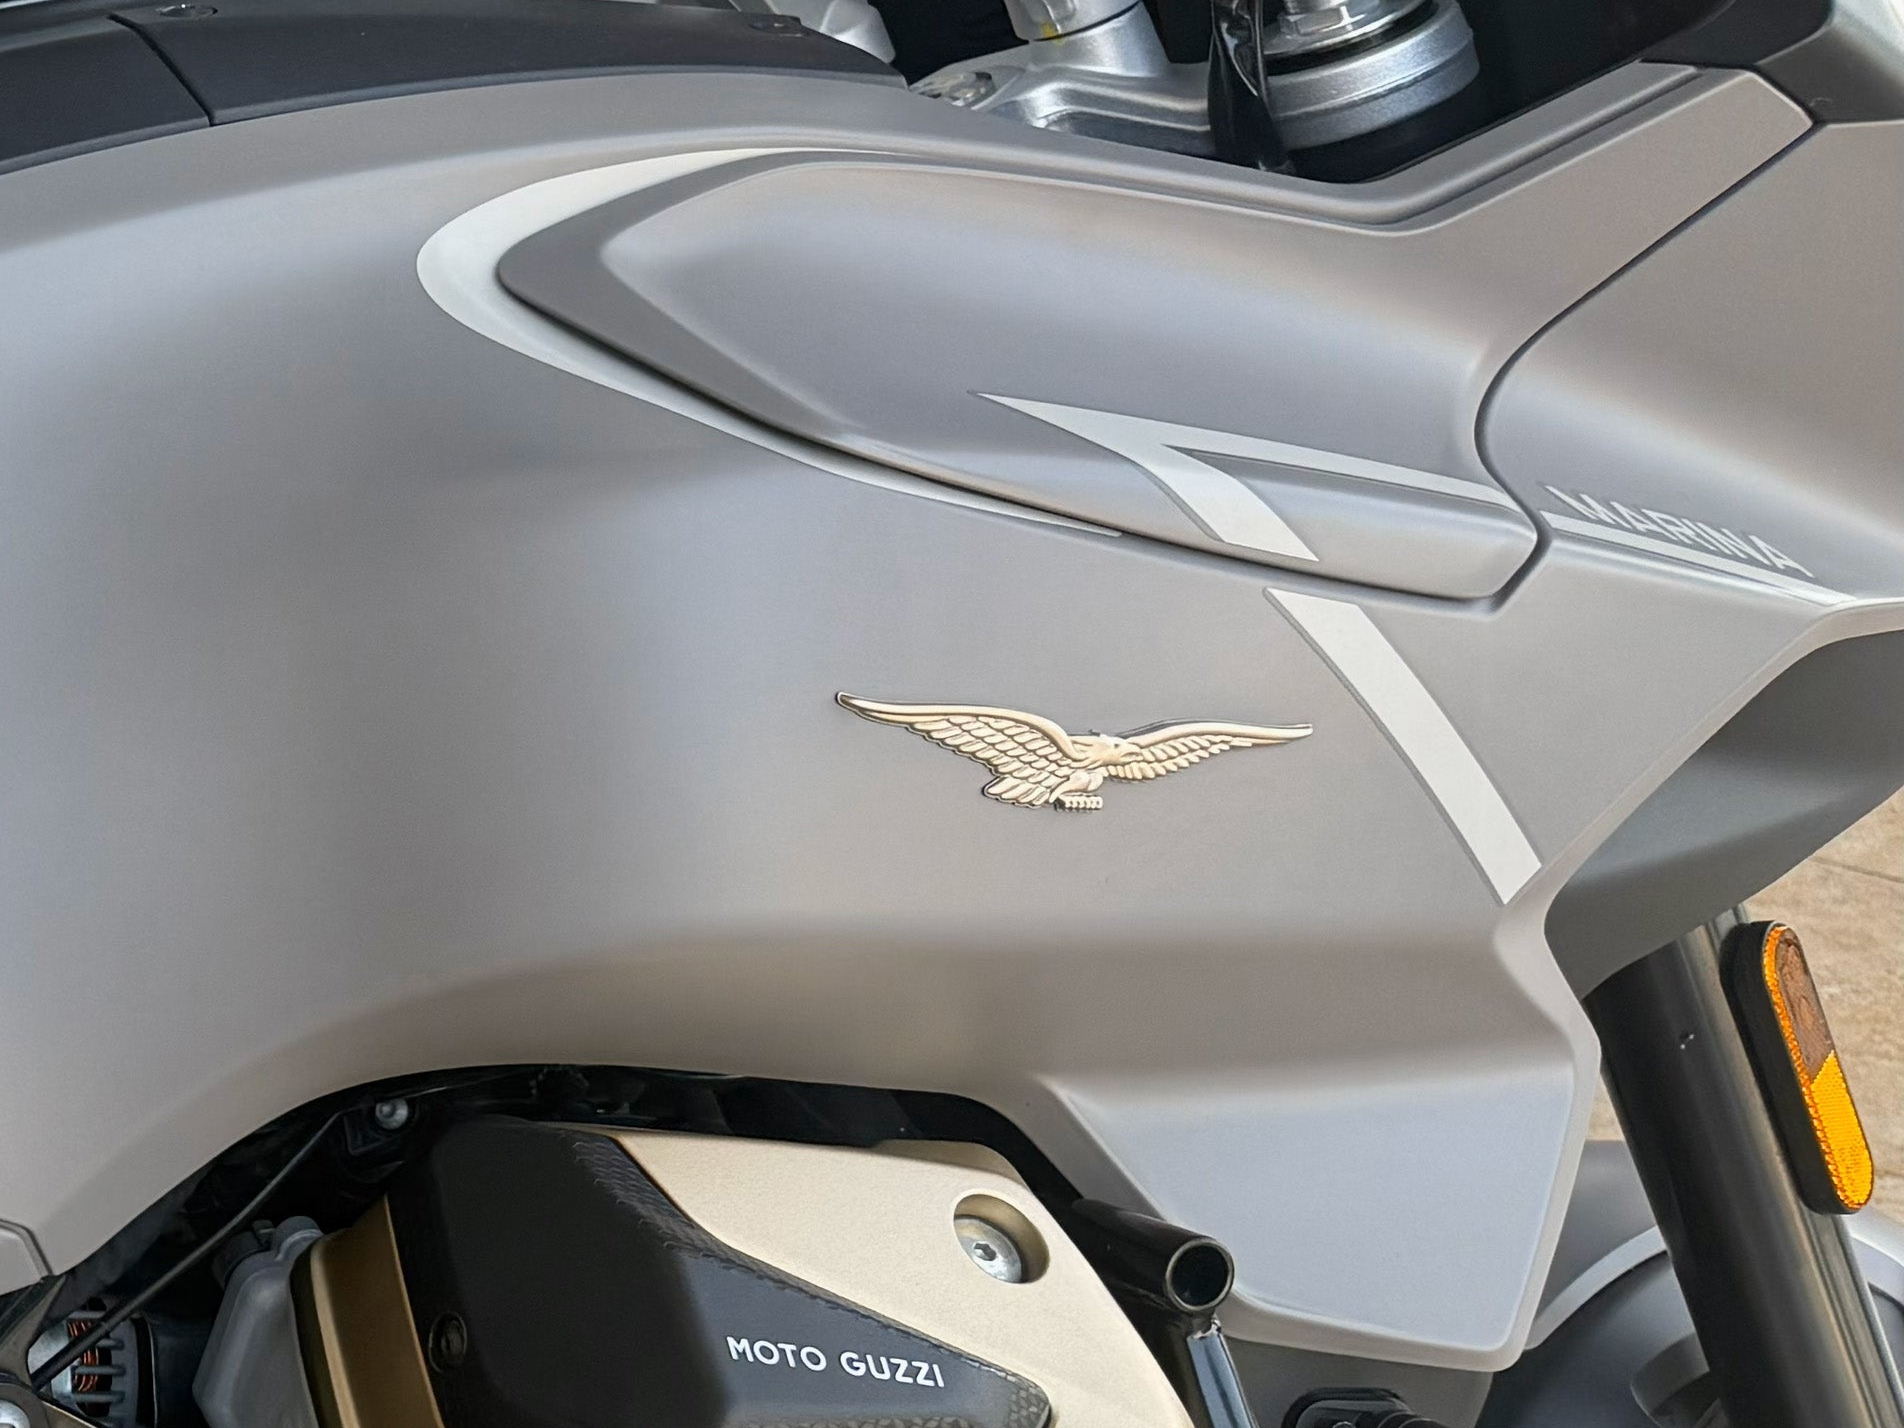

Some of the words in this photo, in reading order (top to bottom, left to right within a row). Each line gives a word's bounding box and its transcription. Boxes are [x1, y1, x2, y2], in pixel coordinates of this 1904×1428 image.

[1544, 484, 1815, 578] MARINA
[726, 1335, 827, 1372] MOTO
[839, 1351, 946, 1388] GUZZI
